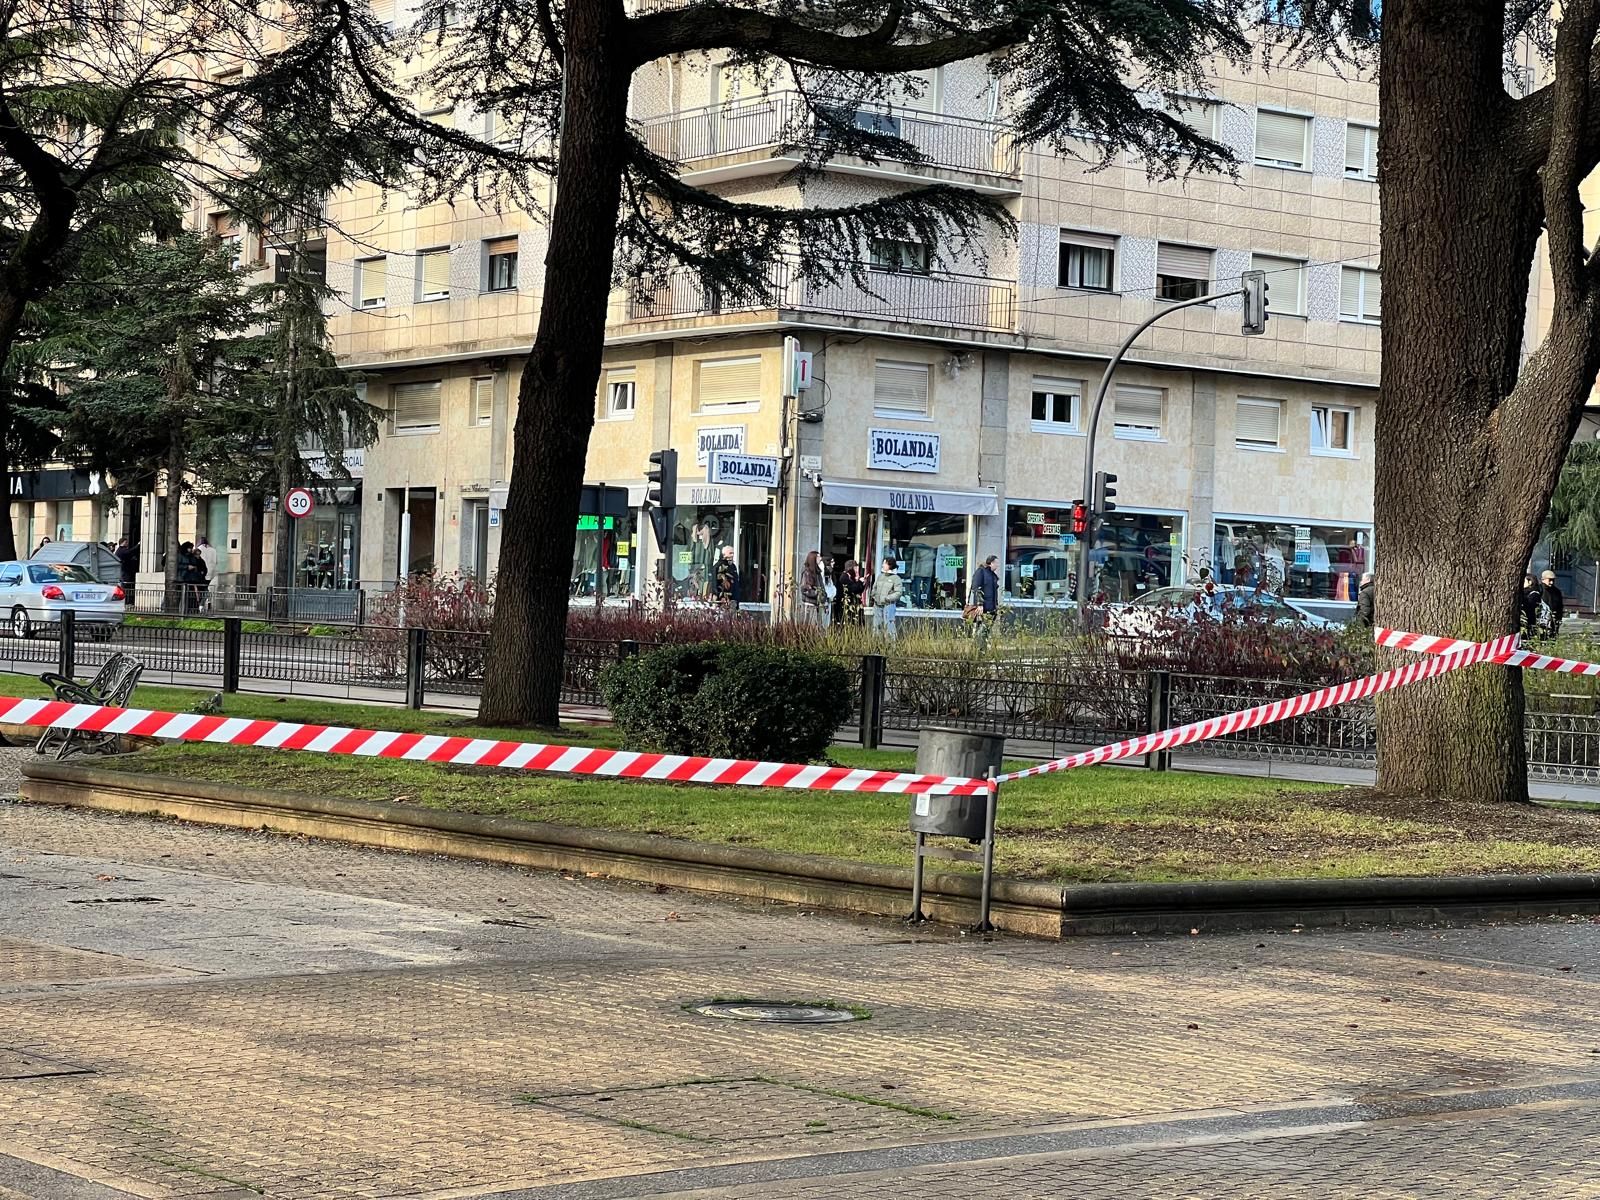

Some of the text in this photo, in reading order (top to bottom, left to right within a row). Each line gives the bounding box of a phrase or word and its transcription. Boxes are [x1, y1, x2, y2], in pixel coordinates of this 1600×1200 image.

[699, 433, 740, 452] BOLANDA
[875, 437, 935, 459] BOLANDA
[721, 460, 773, 478] BOLANDA
[291, 497, 308, 508] 30
[690, 488, 722, 504] BOLANDA
[889, 492, 936, 511] BOLANDA
[1027, 513, 1044, 523] OFERTAS
[1043, 524, 1060, 534] OFERTAS
[945, 557, 964, 567] OFERTAS
